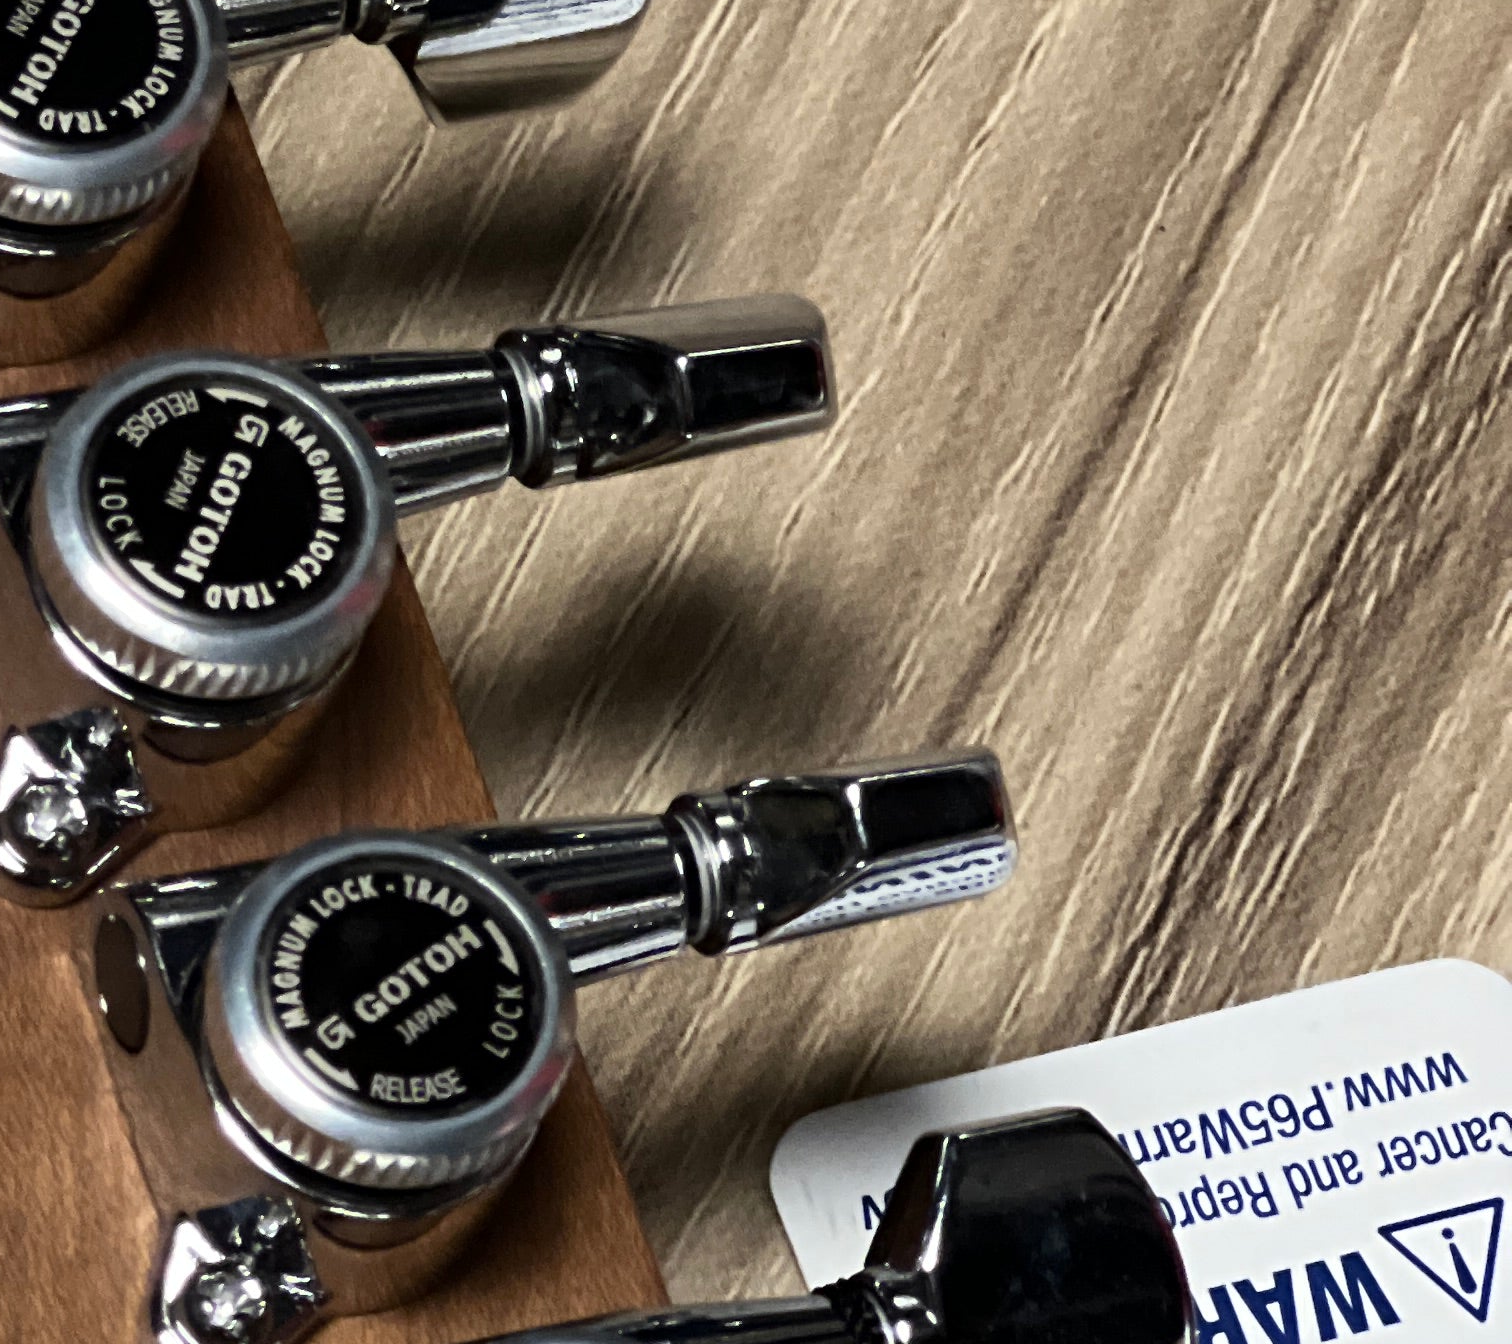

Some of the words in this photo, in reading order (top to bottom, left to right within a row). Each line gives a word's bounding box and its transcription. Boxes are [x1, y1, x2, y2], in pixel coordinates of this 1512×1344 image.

[38, 108, 108, 134] TRAD
[119, 64, 177, 119] LOCK
[116, 389, 201, 448] RELEASE
[163, 448, 207, 511] JAPAN
[278, 414, 347, 524] MAGNUM
[98, 475, 143, 552] LOCK
[174, 452, 253, 584] GOTOH
[285, 529, 340, 590] LOCK
[204, 582, 276, 610] TRAD
[272, 913, 320, 1030] MAGNUM
[309, 873, 379, 919] LOCK
[402, 874, 470, 917] TRAD
[353, 923, 484, 1023] GOTOH
[394, 992, 458, 1046] JAPAN
[482, 984, 524, 1060] LOCK
[370, 1067, 468, 1104] RELEASE
[1376, 1111, 1512, 1177] Cancer
[1282, 1149, 1364, 1210] and
